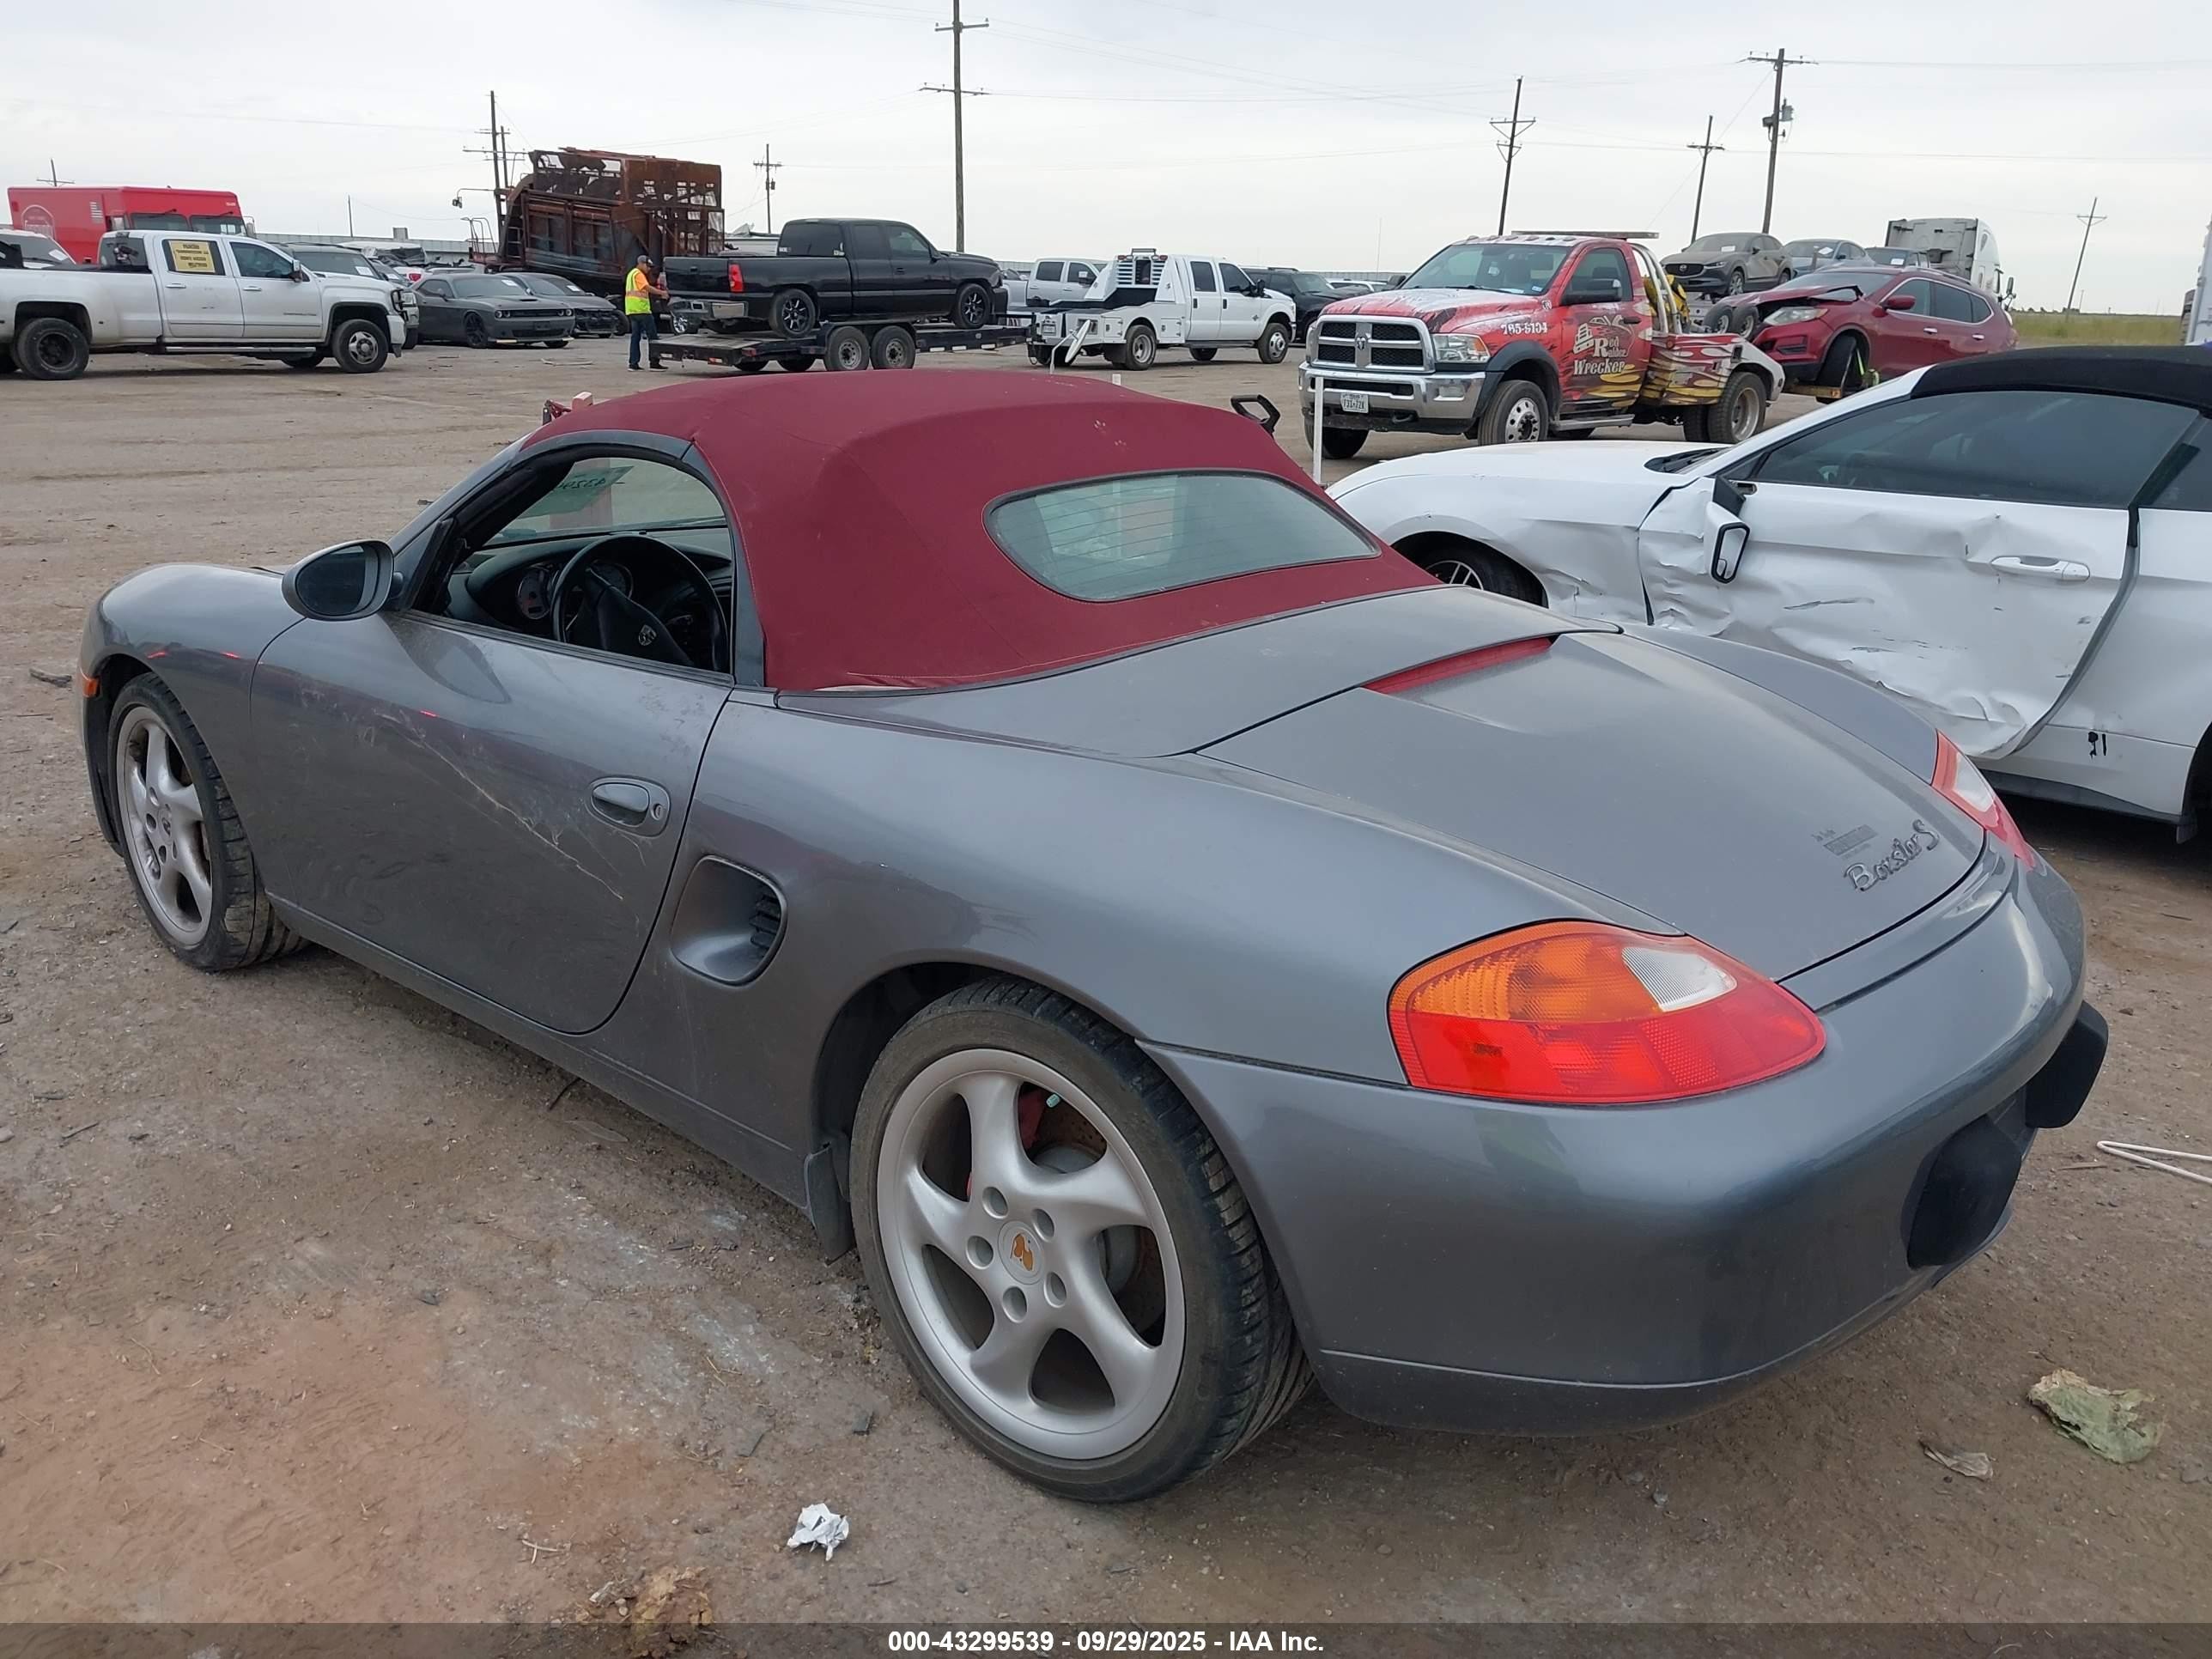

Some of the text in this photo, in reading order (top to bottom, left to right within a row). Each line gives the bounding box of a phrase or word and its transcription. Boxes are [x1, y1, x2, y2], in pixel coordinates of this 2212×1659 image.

[1573, 357, 1626, 375] Wrecker
[1844, 833, 1922, 891] Boxster
[1912, 818, 1941, 851] S
